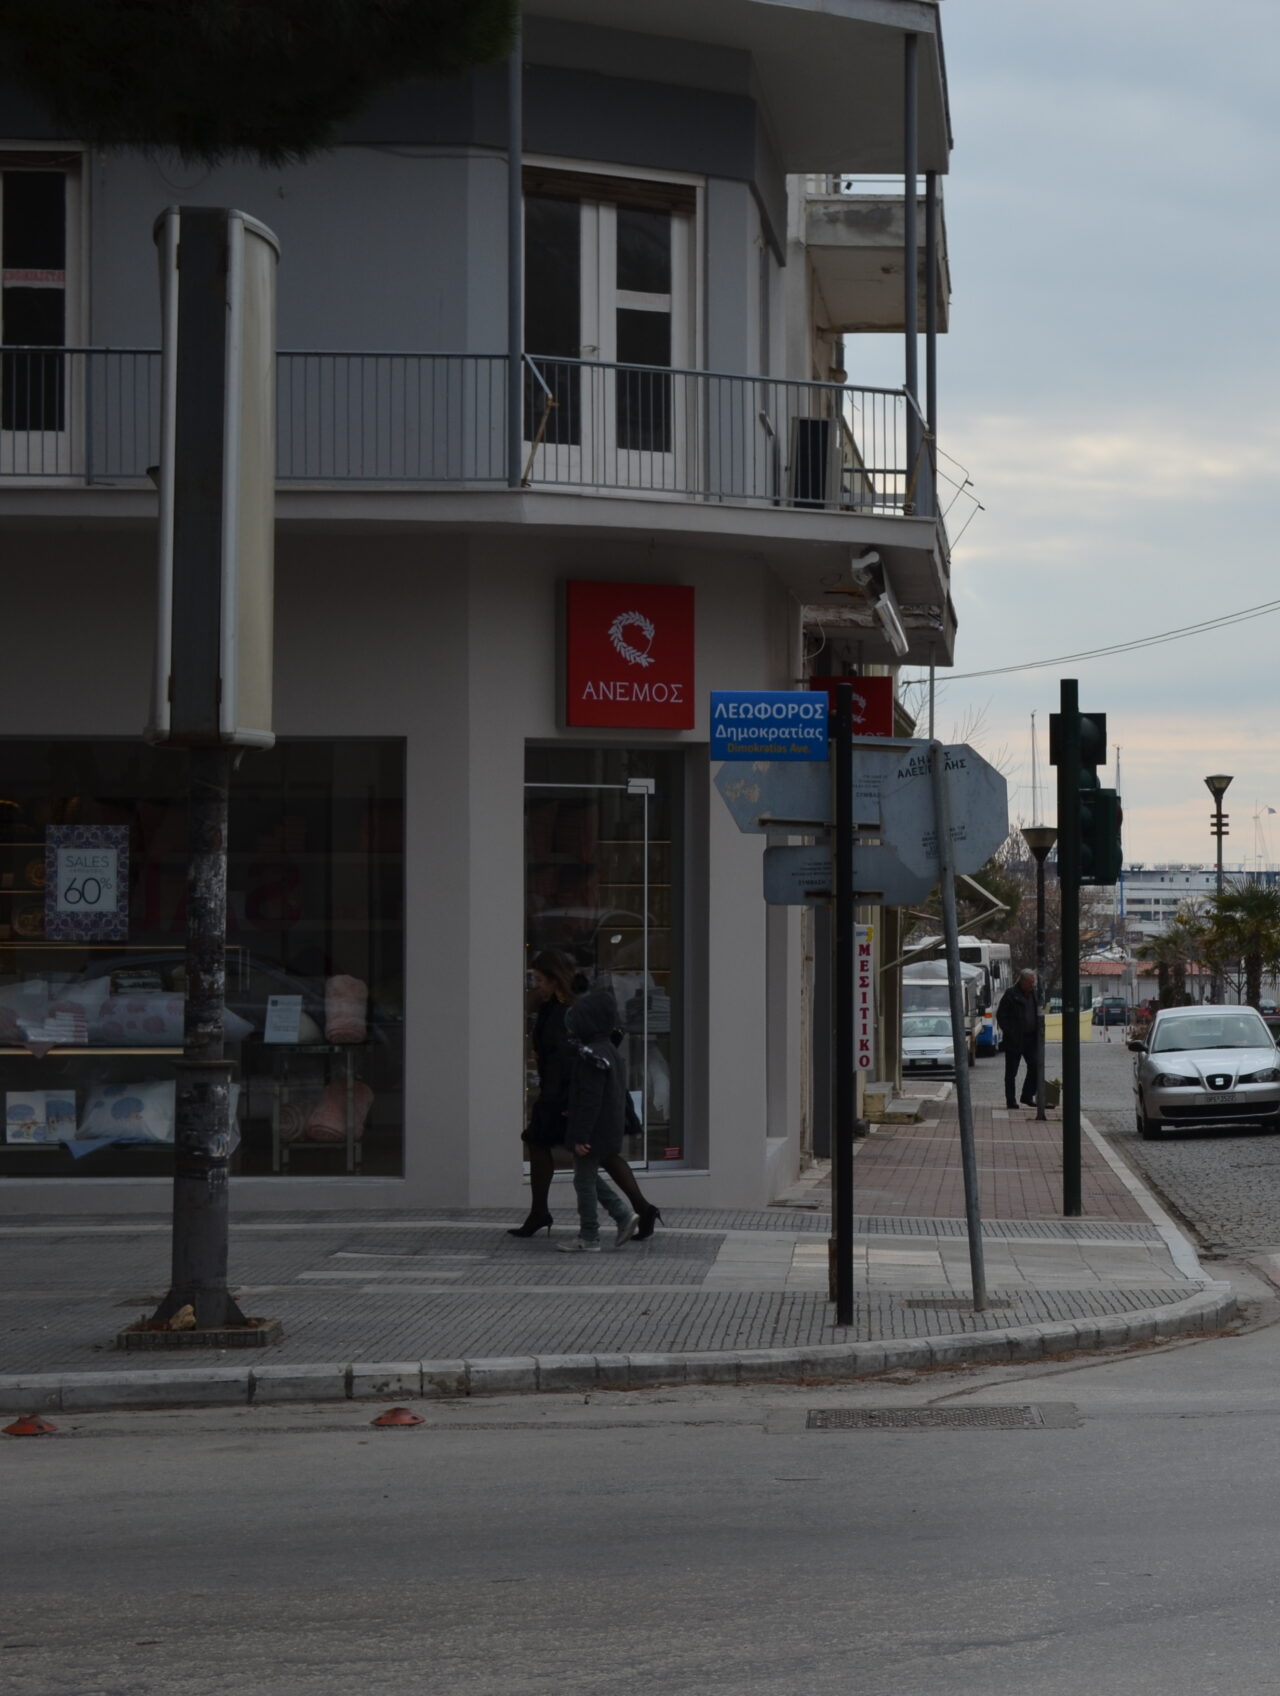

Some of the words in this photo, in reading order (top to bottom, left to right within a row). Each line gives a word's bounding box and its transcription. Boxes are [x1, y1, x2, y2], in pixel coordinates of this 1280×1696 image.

[582, 680, 684, 703] ΑΝΕΜΟΣ
[714, 702, 825, 720] ΛΕΩΦΟΡΟΣ
[715, 723, 824, 742] Δημοκρατίας
[727, 743, 788, 753] Dimokratias
[65, 855, 110, 868] SALES
[858, 943, 871, 1068] ΜΕΣΙΤΙΚΟ
